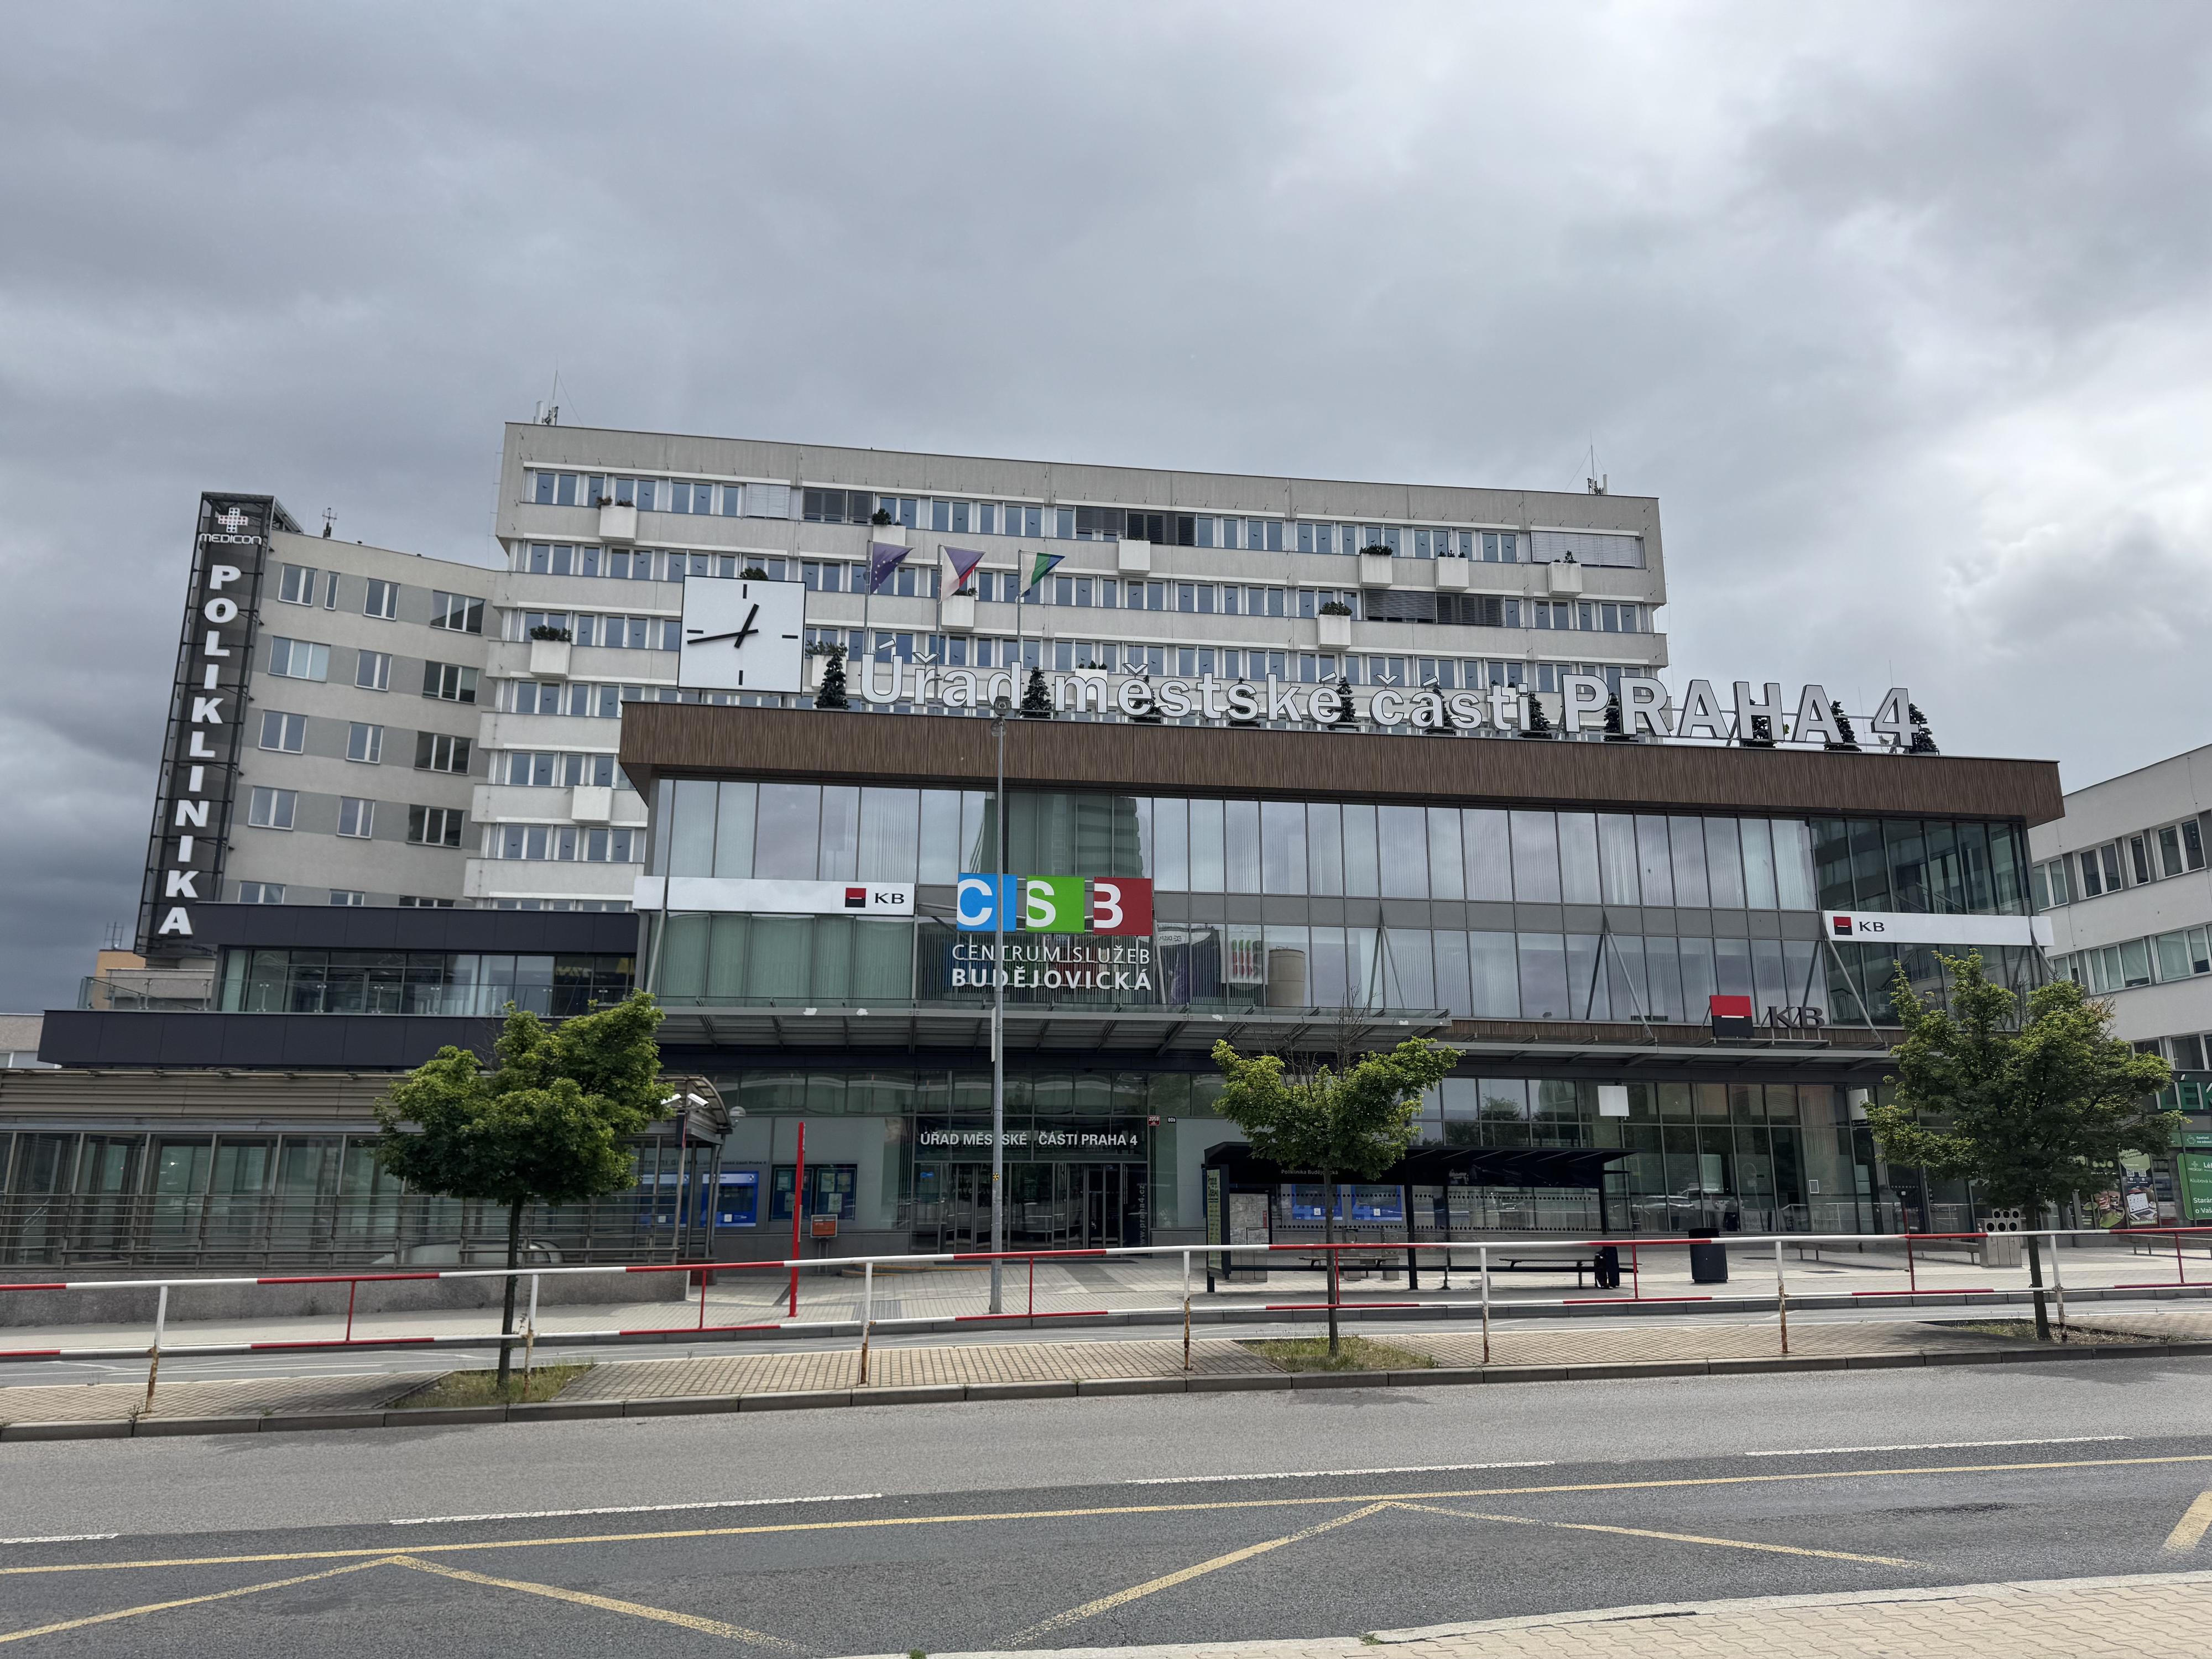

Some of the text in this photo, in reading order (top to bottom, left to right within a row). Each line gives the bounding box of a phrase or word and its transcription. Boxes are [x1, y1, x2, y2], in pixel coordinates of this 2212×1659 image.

[860, 638, 1919, 747] Úřad městské části PRAHA 4
[158, 565, 241, 935] POLIKLINIKA
[875, 893, 905, 904] KB
[1859, 921, 1885, 932] KB
[952, 945, 1150, 964] CENTRUM SLUŽEB
[952, 966, 1152, 991] BUDĚJOVICKÁ
[1767, 1006, 1825, 1029] KB
[920, 1131, 959, 1145] ÚŘAD
[963, 1131, 1027, 1145] MĚSSKÉ
[1039, 1131, 1077, 1145] ČÁSTI
[1081, 1134, 1126, 1145] PRAHA
[1130, 1135, 1138, 1145] 4
